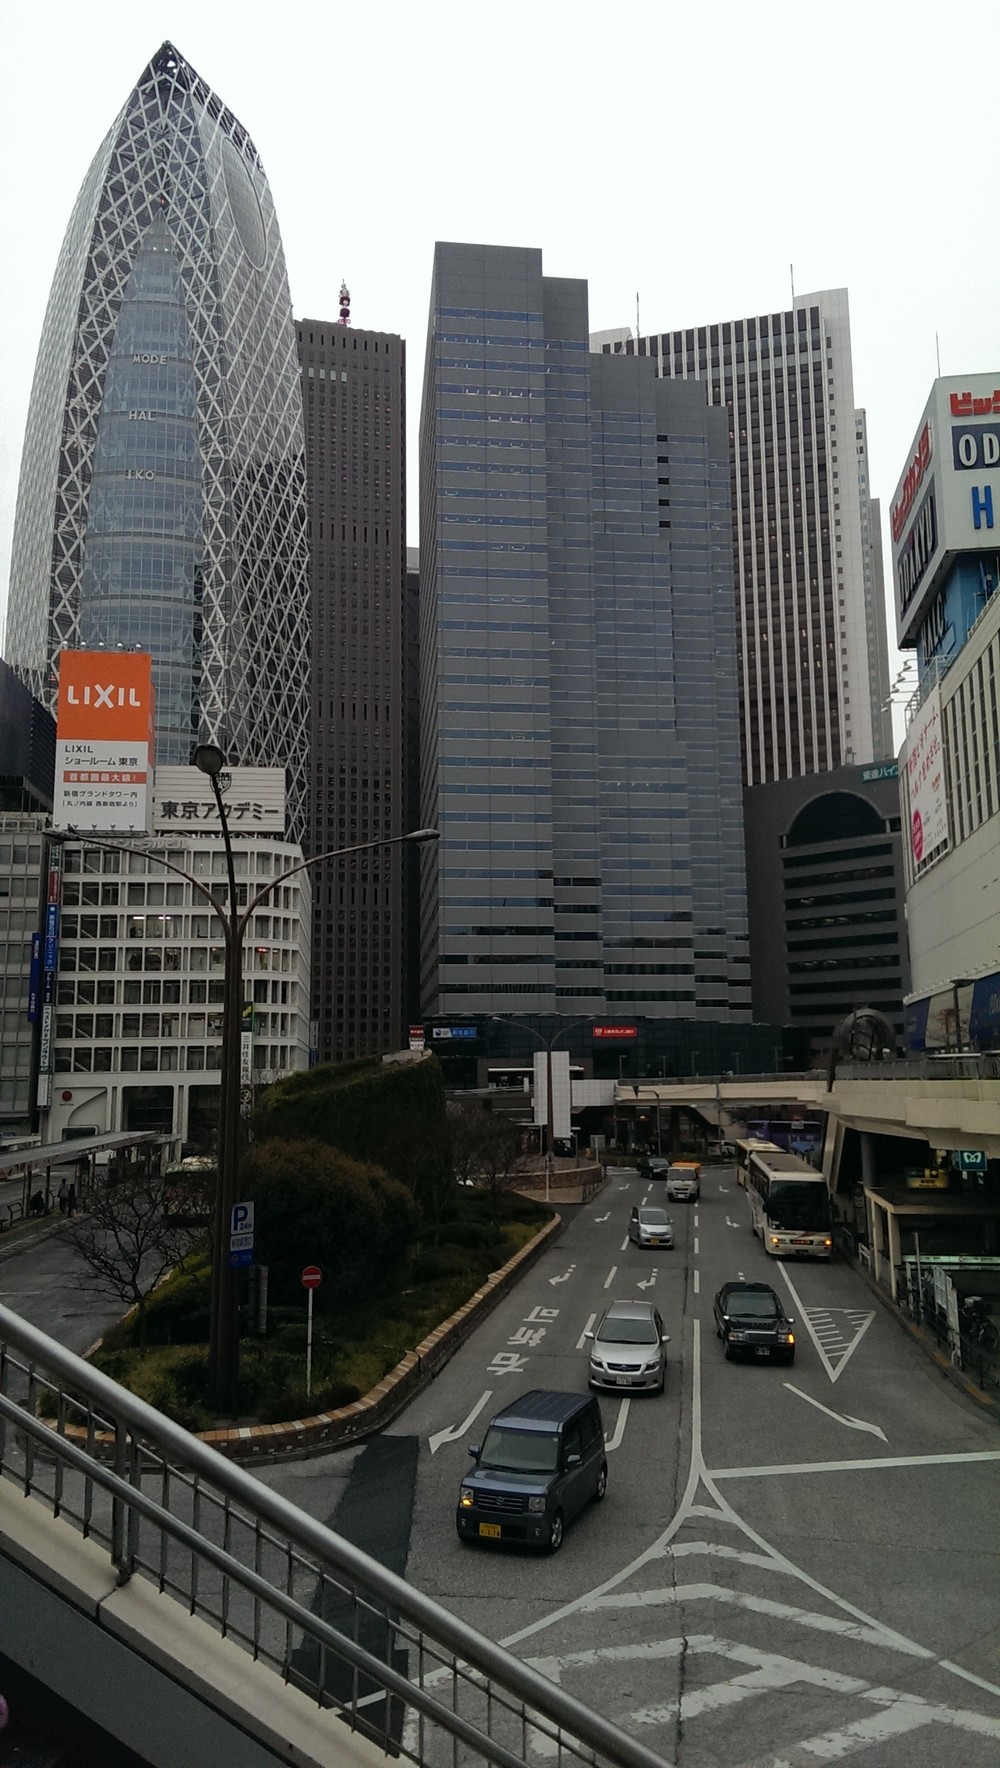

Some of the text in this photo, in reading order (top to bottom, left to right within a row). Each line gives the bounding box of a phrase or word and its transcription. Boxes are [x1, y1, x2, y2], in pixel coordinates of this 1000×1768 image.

[132, 354, 168, 365] MODE
[128, 410, 156, 421] HAL
[898, 495, 934, 612] ODAKYU
[67, 684, 141, 708] LIXIL
[65, 745, 94, 753] LIXIL
[65, 756, 138, 766] ショールーム 東京
[161, 800, 279, 820] 東京アカデミー
[234, 1206, 248, 1231] P
